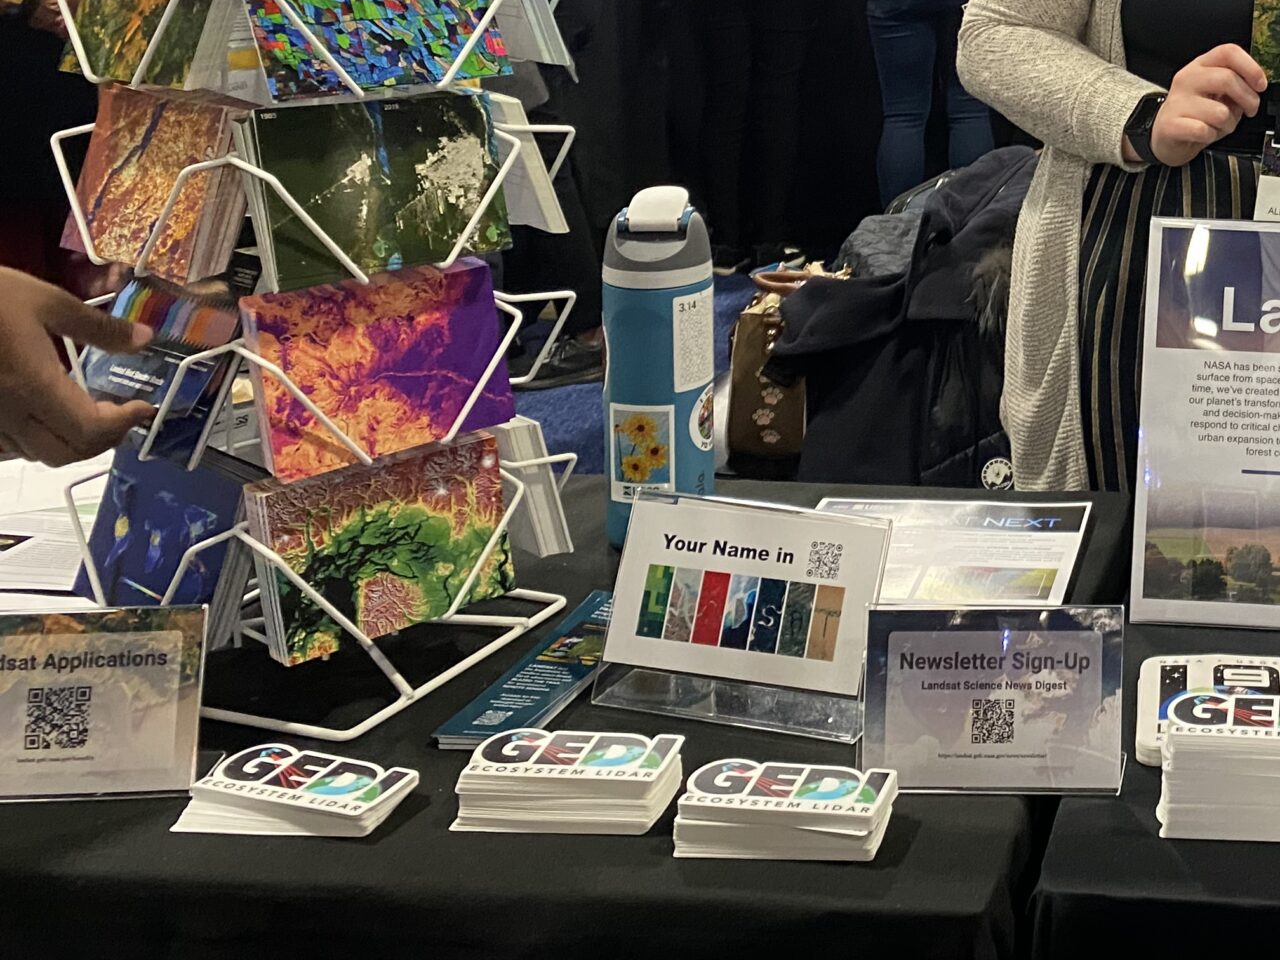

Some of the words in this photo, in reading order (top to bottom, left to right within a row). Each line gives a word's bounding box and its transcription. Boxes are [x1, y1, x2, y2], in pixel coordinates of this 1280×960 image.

[678, 301, 697, 313] 3.14
[1204, 360, 1231, 371] NASA
[1234, 362, 1250, 371] has
[1253, 363, 1275, 373] been
[1197, 373, 1230, 383] surface
[1233, 374, 1253, 384] from
[1192, 384, 1214, 395] time,
[1217, 385, 1242, 395] we've
[1245, 387, 1279, 397] created
[1189, 397, 1203, 405] our
[1206, 397, 1241, 408] planet's
[1203, 408, 1220, 417] and
[1190, 421, 1227, 431] respond
[1230, 421, 1238, 430] to
[1241, 422, 1270, 432] critical
[1198, 433, 1224, 443] urban
[1227, 436, 1273, 446] expansion
[1246, 447, 1271, 457] forest
[983, 518, 1062, 528] NEXT
[663, 533, 707, 554] Your
[712, 540, 770, 561] Name
[776, 547, 794, 564] in
[43, 650, 168, 672] Applications
[900, 652, 1006, 670] Newsletter
[1011, 652, 1090, 674] Sign-Up
[921, 680, 961, 690] Landsat
[963, 681, 1002, 690] Science
[1005, 681, 1032, 690] News
[1035, 681, 1067, 692] Digest
[481, 732, 682, 770] GEDI
[220, 745, 412, 803] GEDI
[468, 764, 588, 779] ECOSYSTEM
[595, 769, 654, 780] LIDAR
[692, 761, 895, 803] GEDI
[201, 778, 302, 802] ECOSYSTEM
[308, 797, 363, 813] LIDAR
[683, 795, 802, 809] ECOSYSTEM
[812, 803, 871, 814] LIDAR
